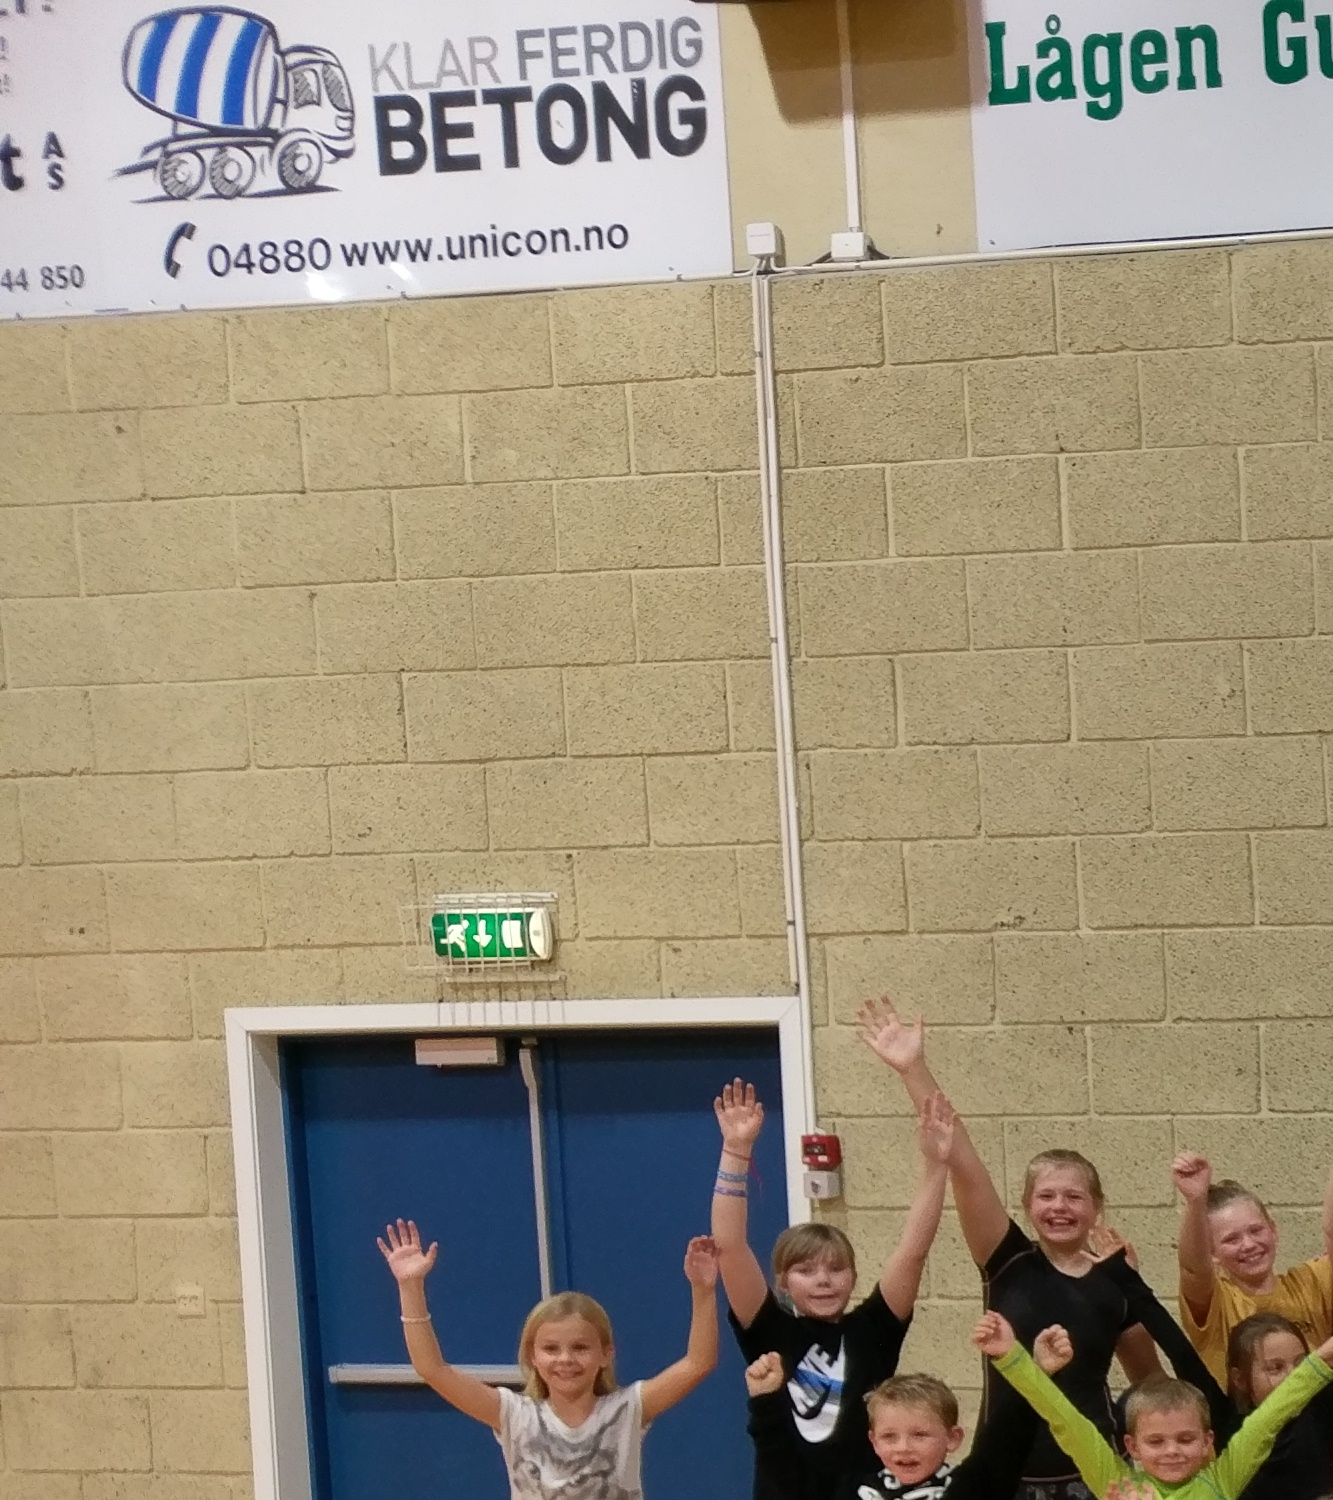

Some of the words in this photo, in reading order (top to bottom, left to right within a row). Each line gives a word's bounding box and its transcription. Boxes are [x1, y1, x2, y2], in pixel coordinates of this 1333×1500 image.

[368, 36, 502, 92] KLAR
[516, 17, 703, 77] FERDIG
[985, 14, 1222, 120] Lågen
[372, 75, 708, 177] BETONG
[40, 263, 85, 291] 850
[207, 237, 331, 277] 04880
[340, 223, 630, 267] www.unicon.no
